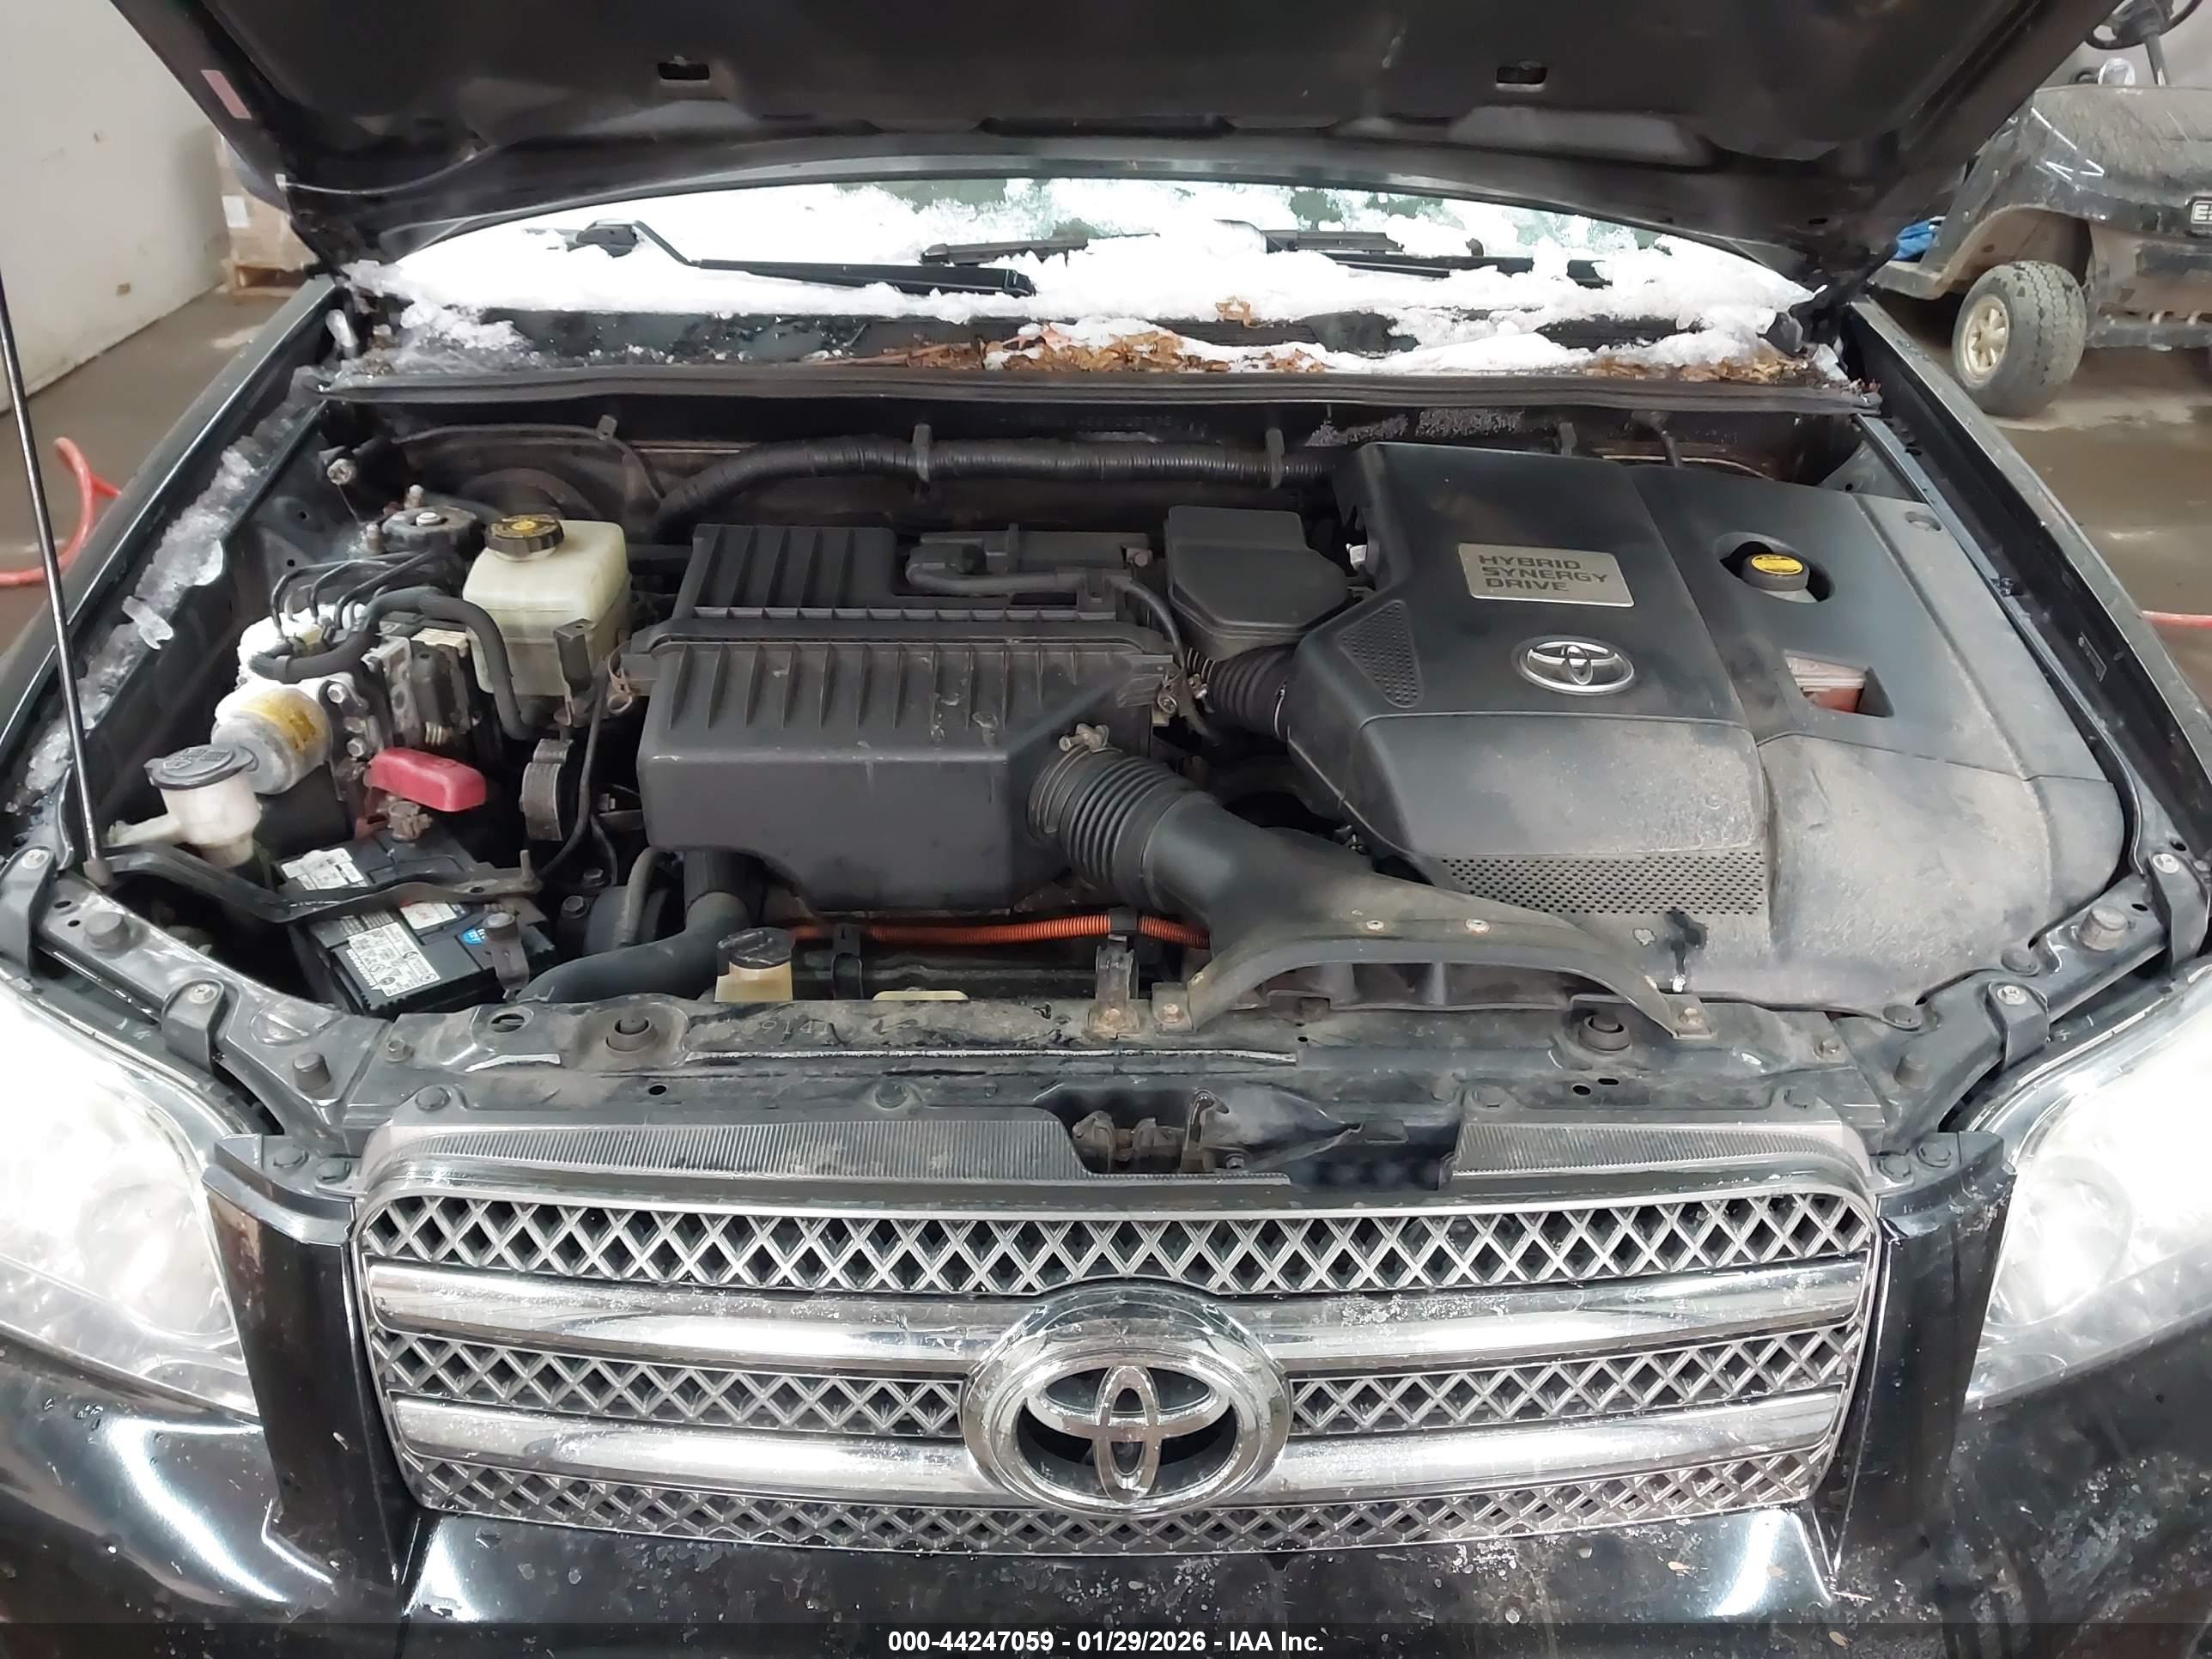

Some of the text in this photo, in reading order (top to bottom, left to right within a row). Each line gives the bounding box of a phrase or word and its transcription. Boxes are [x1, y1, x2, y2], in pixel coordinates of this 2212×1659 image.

[2193, 204, 2212, 221] E
[1478, 555, 1581, 570] HYBRID
[1482, 566, 1608, 583] SYNERGY
[1486, 577, 1570, 592] DRIVE
